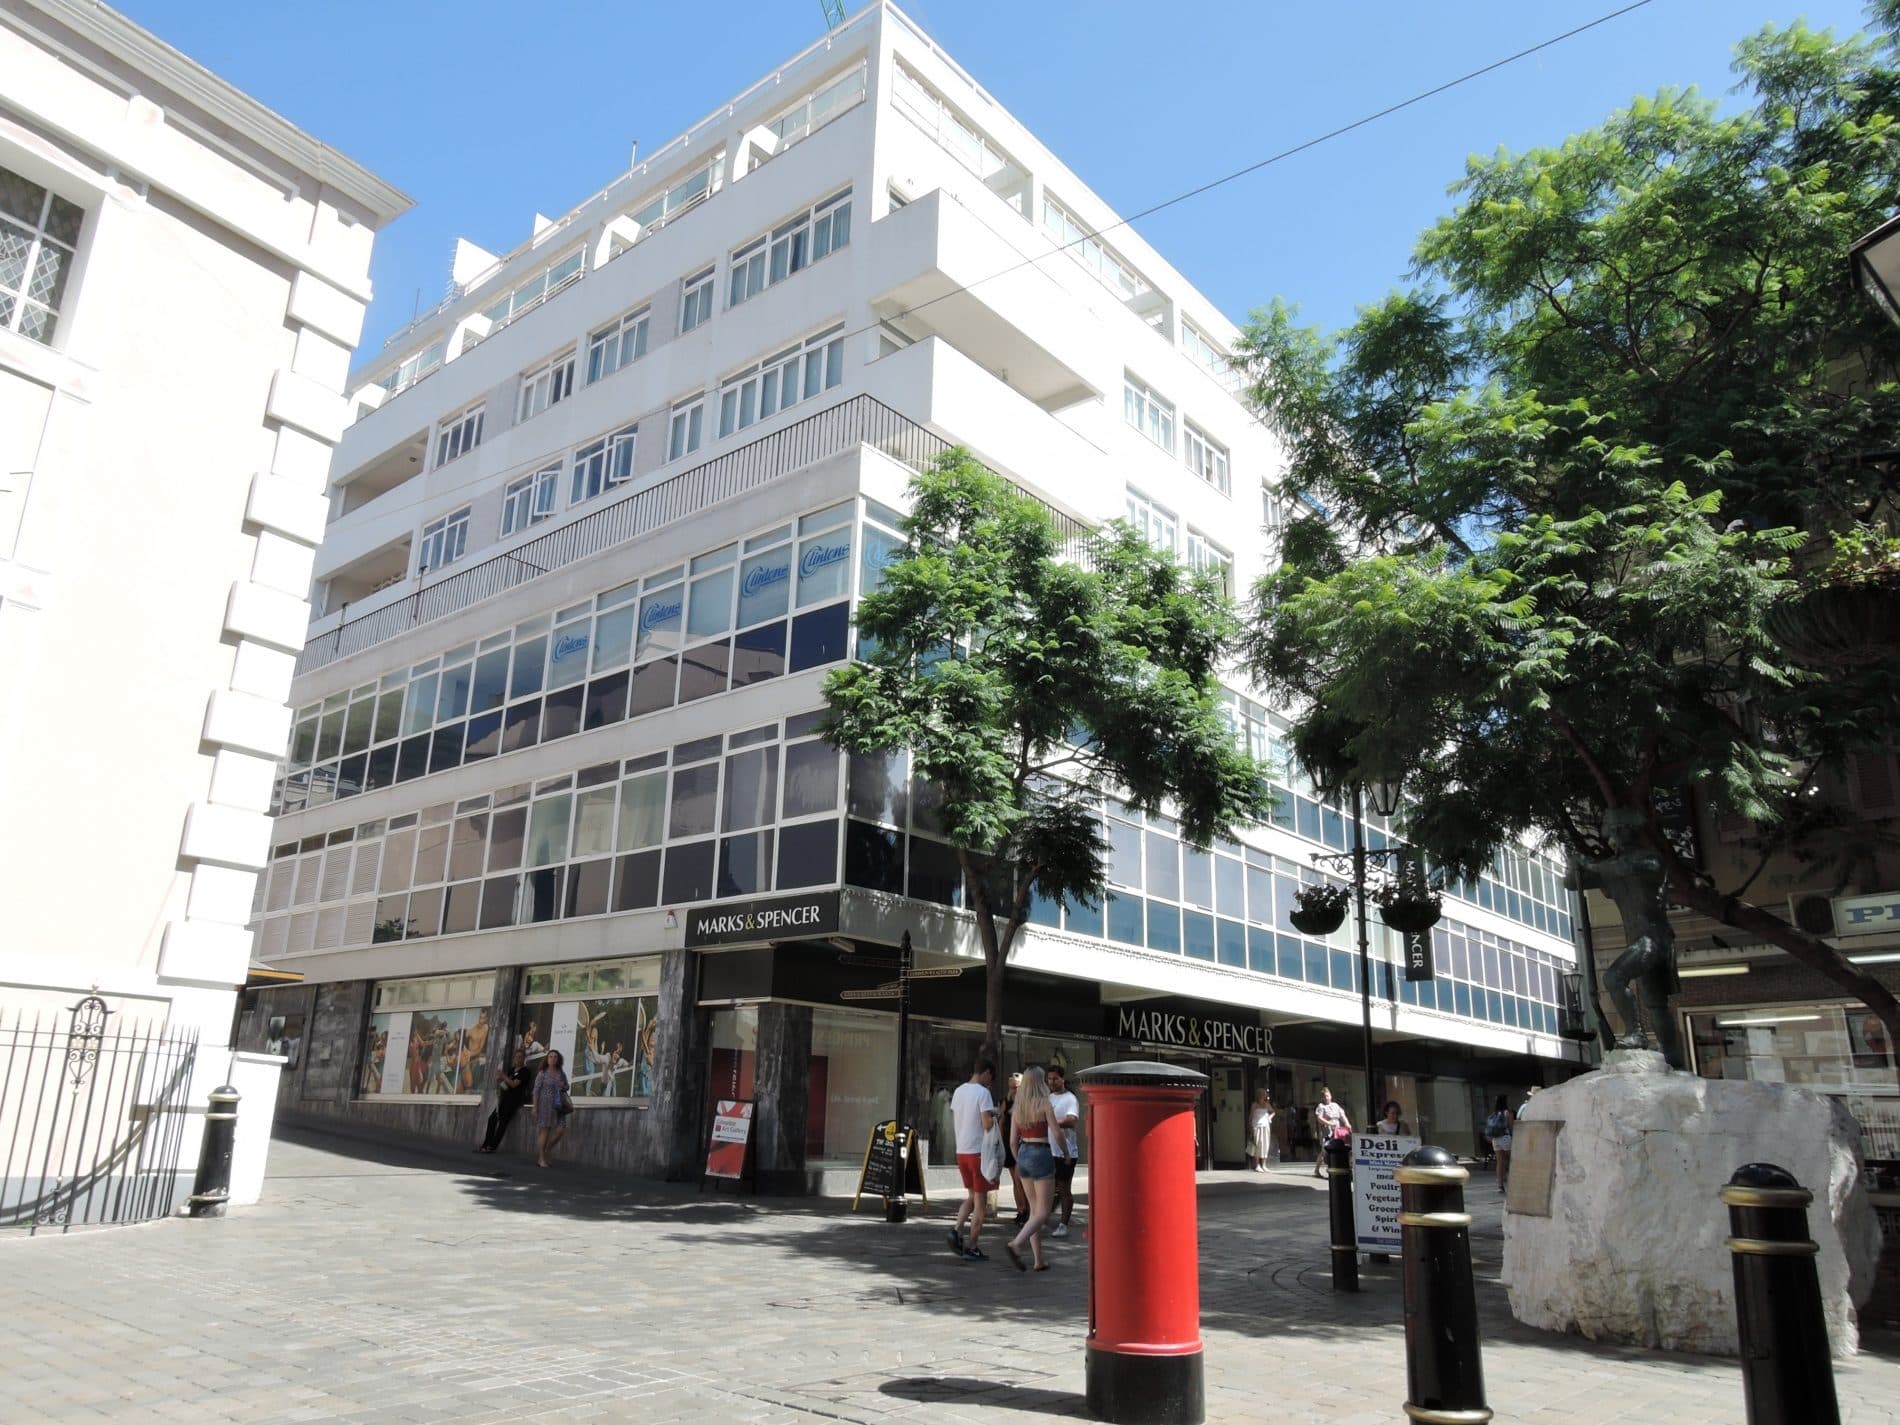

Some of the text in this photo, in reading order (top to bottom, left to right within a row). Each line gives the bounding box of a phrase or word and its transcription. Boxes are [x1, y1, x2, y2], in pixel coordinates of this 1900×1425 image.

[1411, 932, 1424, 968] NCER
[1360, 1138, 1398, 1151] Deli
[1370, 1182, 1401, 1192] Poultr
[1366, 1193, 1400, 1203] Vegetar
[1369, 1204, 1401, 1213] Grocer
[1375, 1215, 1397, 1223] Spiri
